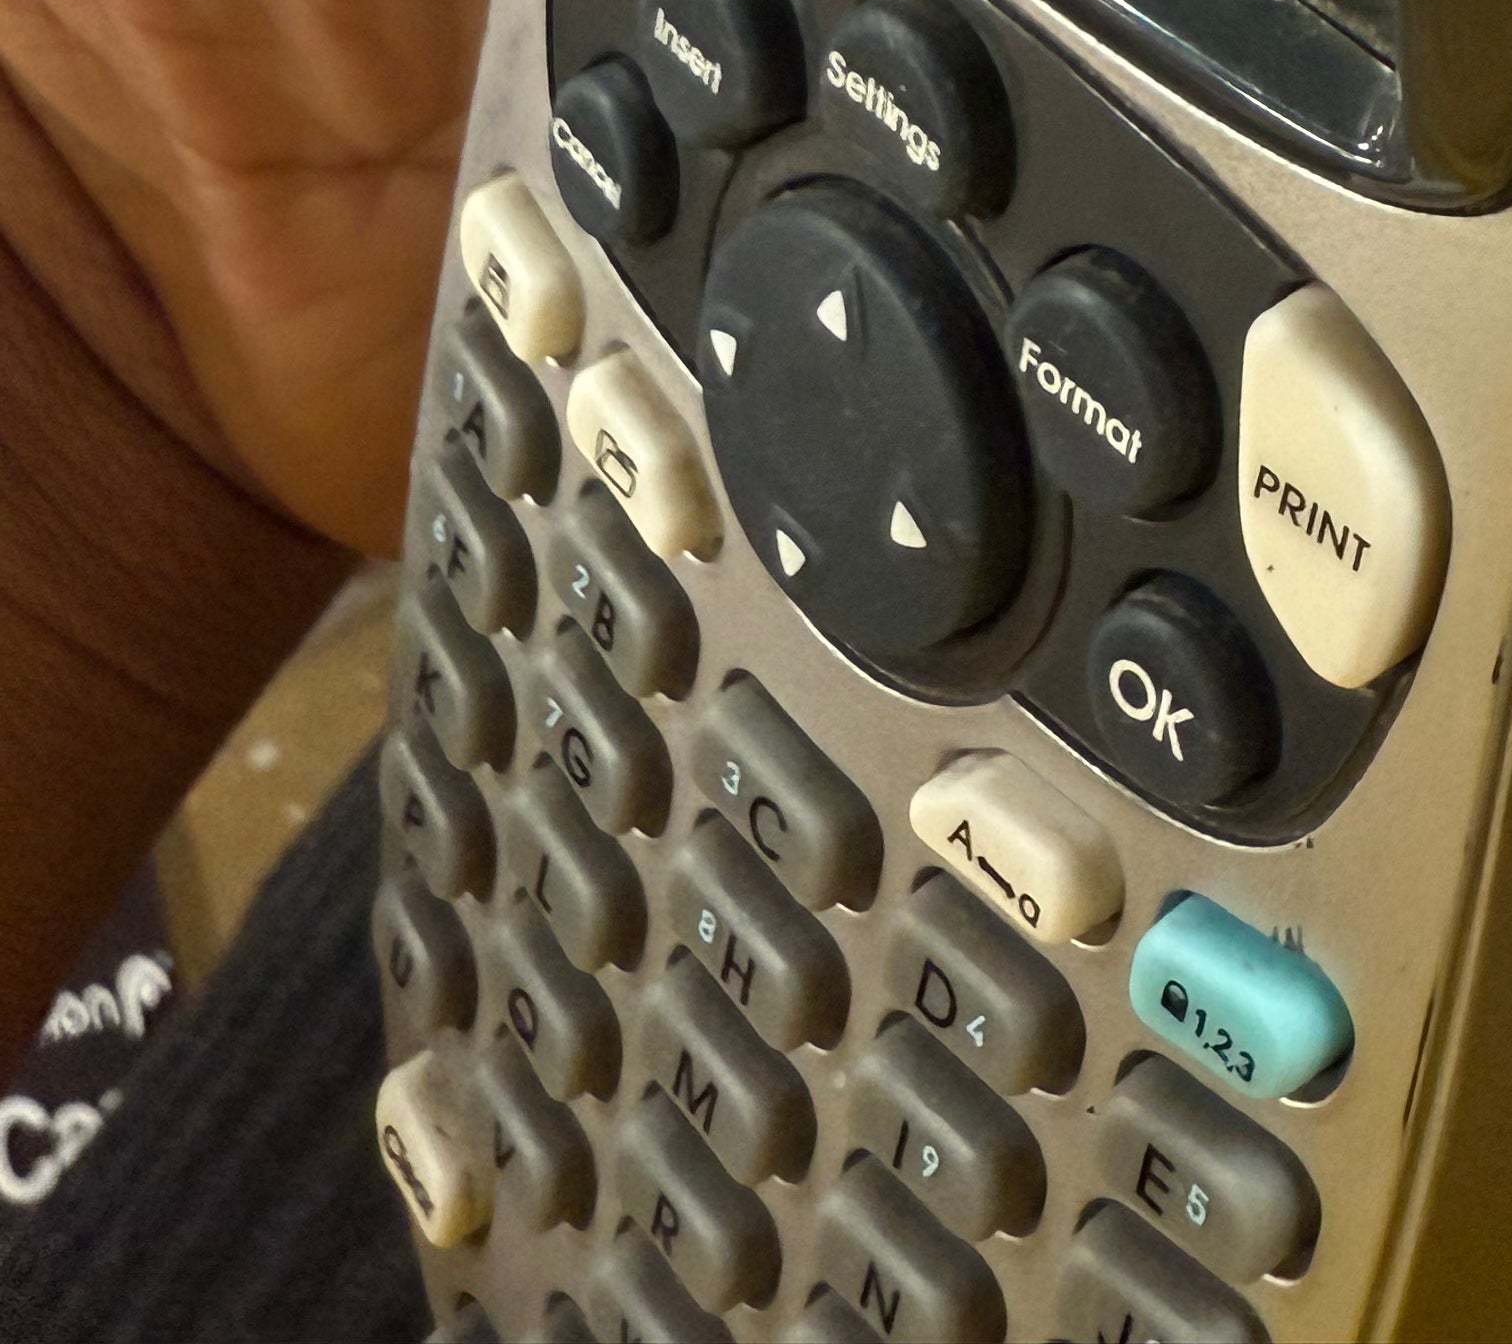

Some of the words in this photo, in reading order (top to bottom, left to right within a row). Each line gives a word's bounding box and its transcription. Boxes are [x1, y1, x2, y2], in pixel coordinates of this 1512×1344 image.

[825, 50, 941, 170] Settings
[462, 400, 488, 460] A
[1018, 337, 1144, 463] Format
[1253, 465, 1372, 572] PRINT
[447, 534, 469, 579] F
[573, 565, 589, 598] 2
[592, 591, 616, 652] B
[415, 652, 442, 714] K
[545, 697, 564, 727] 7
[1108, 659, 1195, 761] OK
[561, 727, 593, 788] G
[749, 796, 789, 862] C
[536, 854, 553, 912] L
[720, 934, 757, 1005] H
[914, 958, 958, 1029] D
[673, 1049, 720, 1133] M
[920, 1145, 941, 1178] 9
[1136, 1143, 1177, 1216] E
[1185, 1183, 1210, 1227] 5
[651, 1193, 680, 1256] R
[860, 1260, 901, 1335] N
